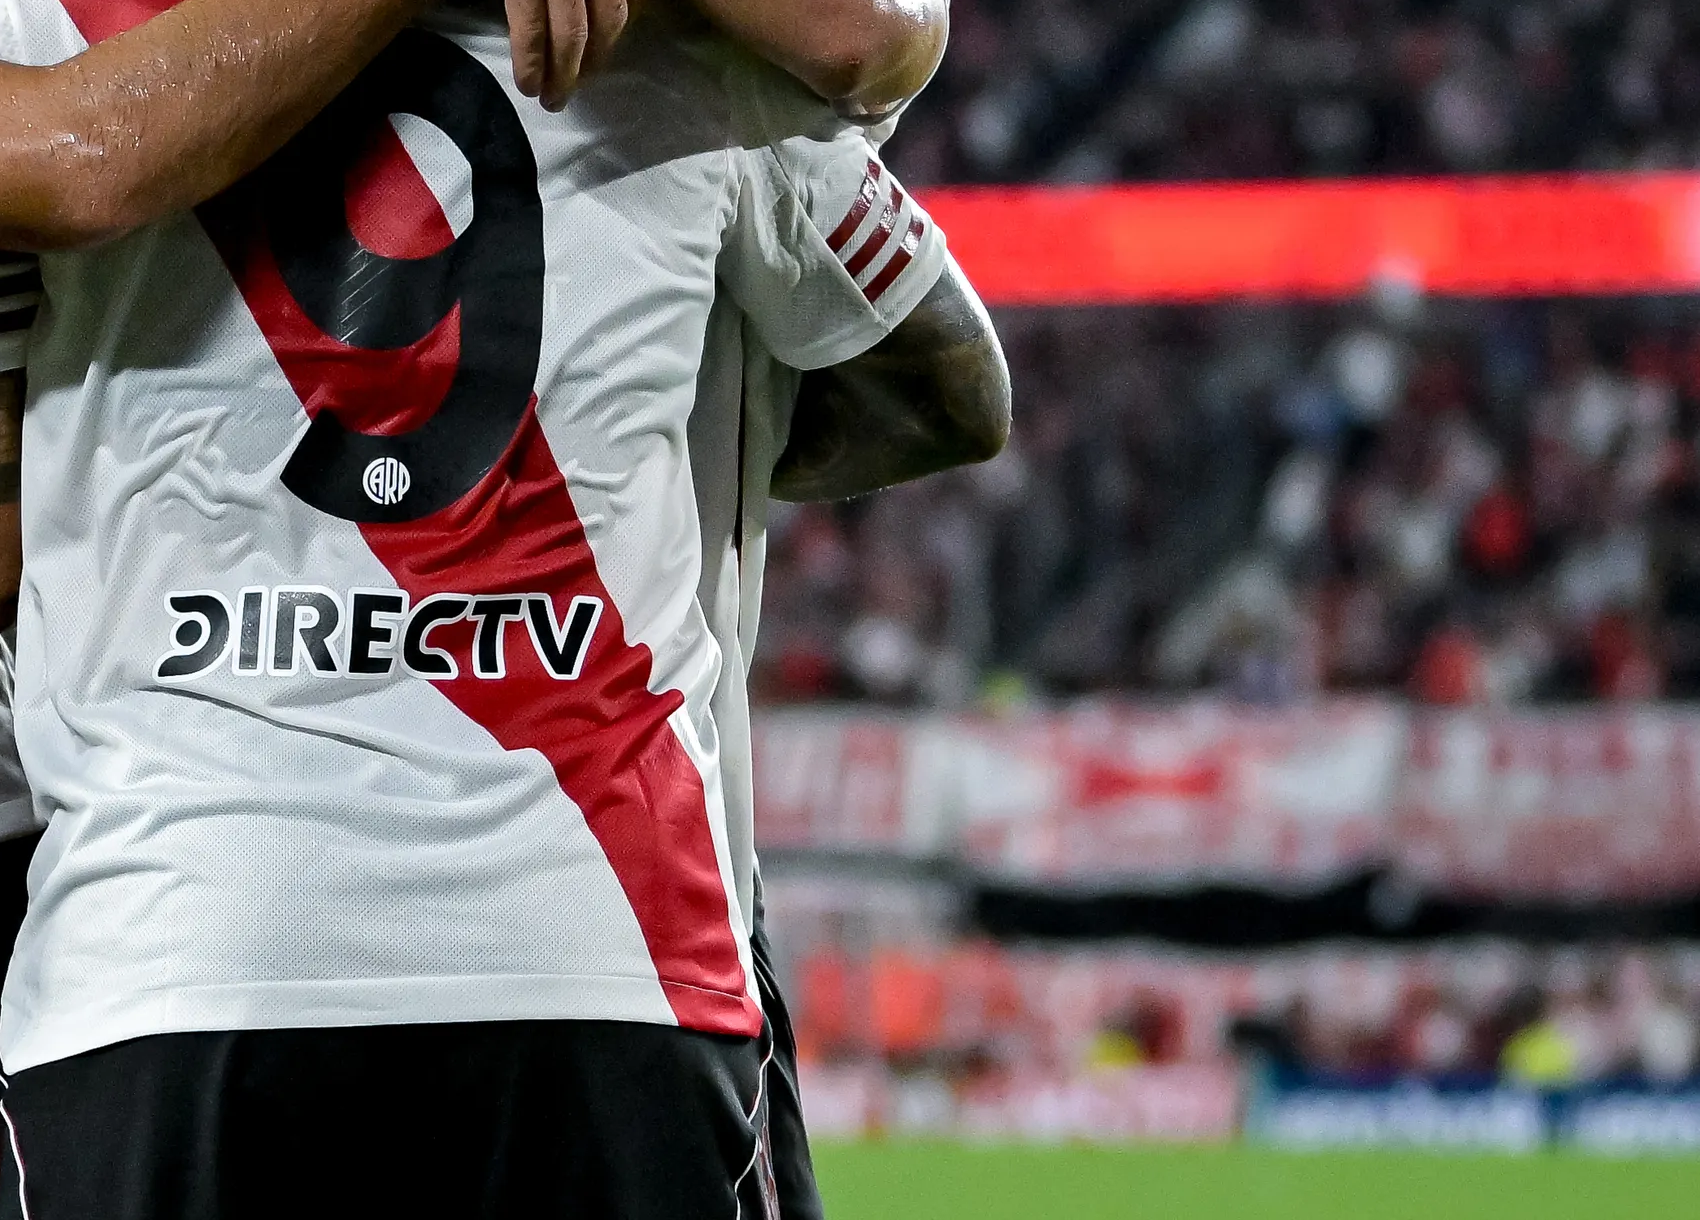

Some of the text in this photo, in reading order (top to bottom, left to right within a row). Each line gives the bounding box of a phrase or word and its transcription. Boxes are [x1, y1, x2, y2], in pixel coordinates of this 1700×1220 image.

[264, 28, 546, 523] 9
[362, 456, 411, 506] CARP
[153, 584, 604, 682] DIRECTV
